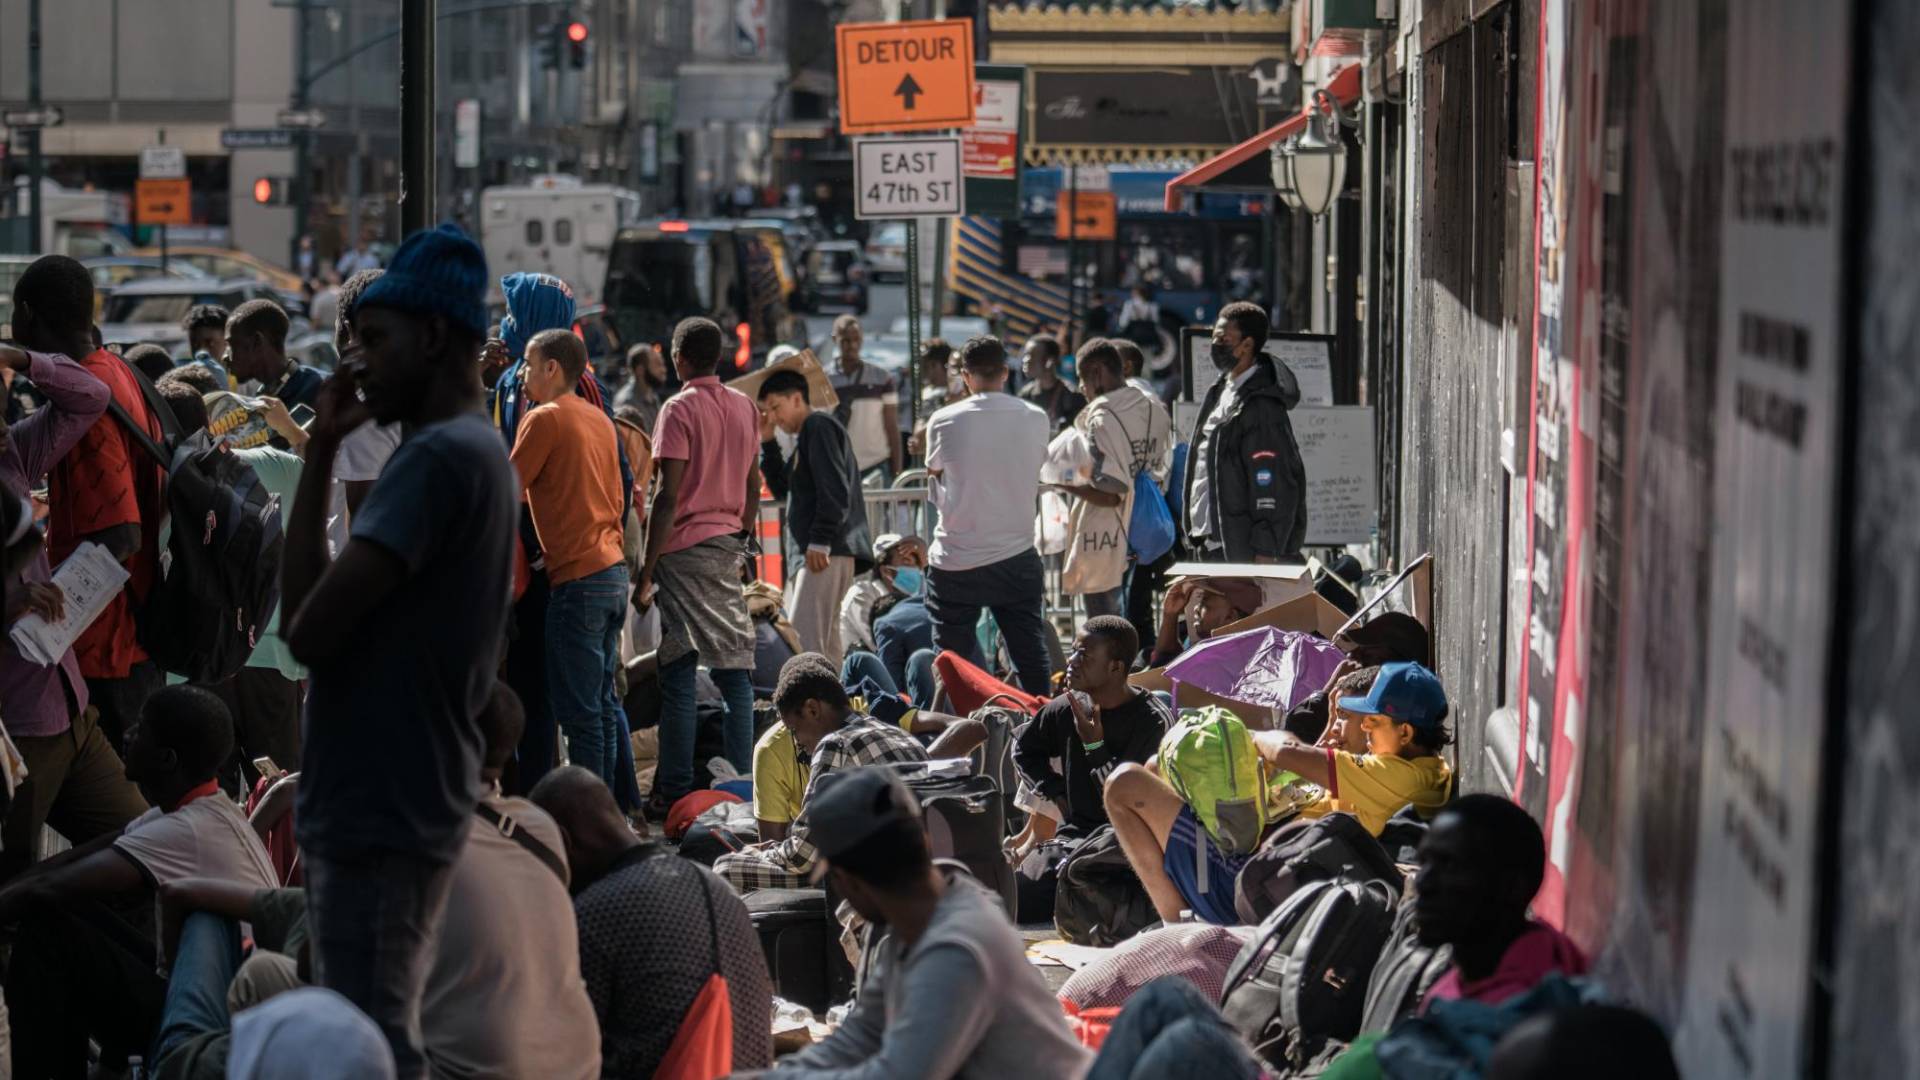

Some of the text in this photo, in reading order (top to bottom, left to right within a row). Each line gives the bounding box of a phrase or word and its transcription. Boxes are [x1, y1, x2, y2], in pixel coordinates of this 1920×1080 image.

[857, 37, 955, 64] DETOUR
[881, 152, 937, 174] EAST
[867, 181, 952, 203] 47th ST
